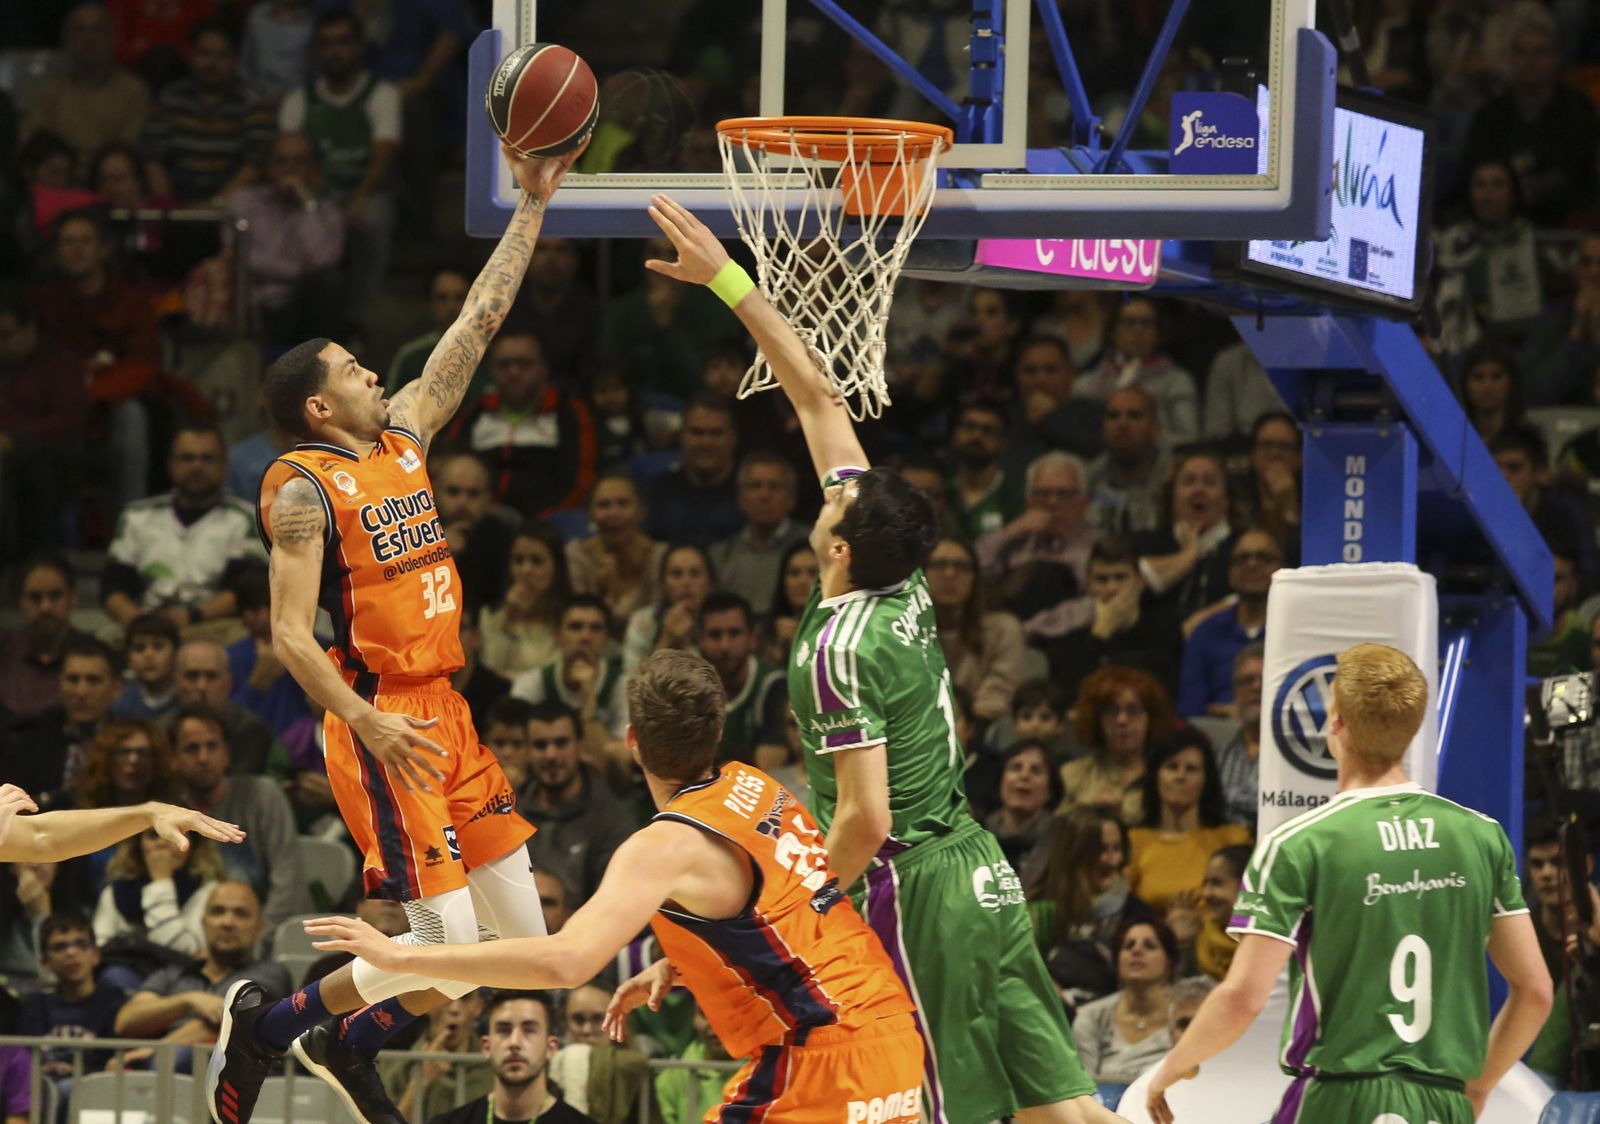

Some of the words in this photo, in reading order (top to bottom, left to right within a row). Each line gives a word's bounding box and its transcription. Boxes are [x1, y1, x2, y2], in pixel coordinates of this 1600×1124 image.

[1194, 134, 1255, 148] endesa
[1195, 118, 1218, 137] liga
[1342, 455, 1366, 563] MONDO
[420, 565, 456, 620] 32
[723, 769, 766, 820] PLEISS
[1262, 790, 1330, 811] Málaga
[1376, 816, 1441, 852] DÍAZ
[1386, 933, 1433, 1044] 9
